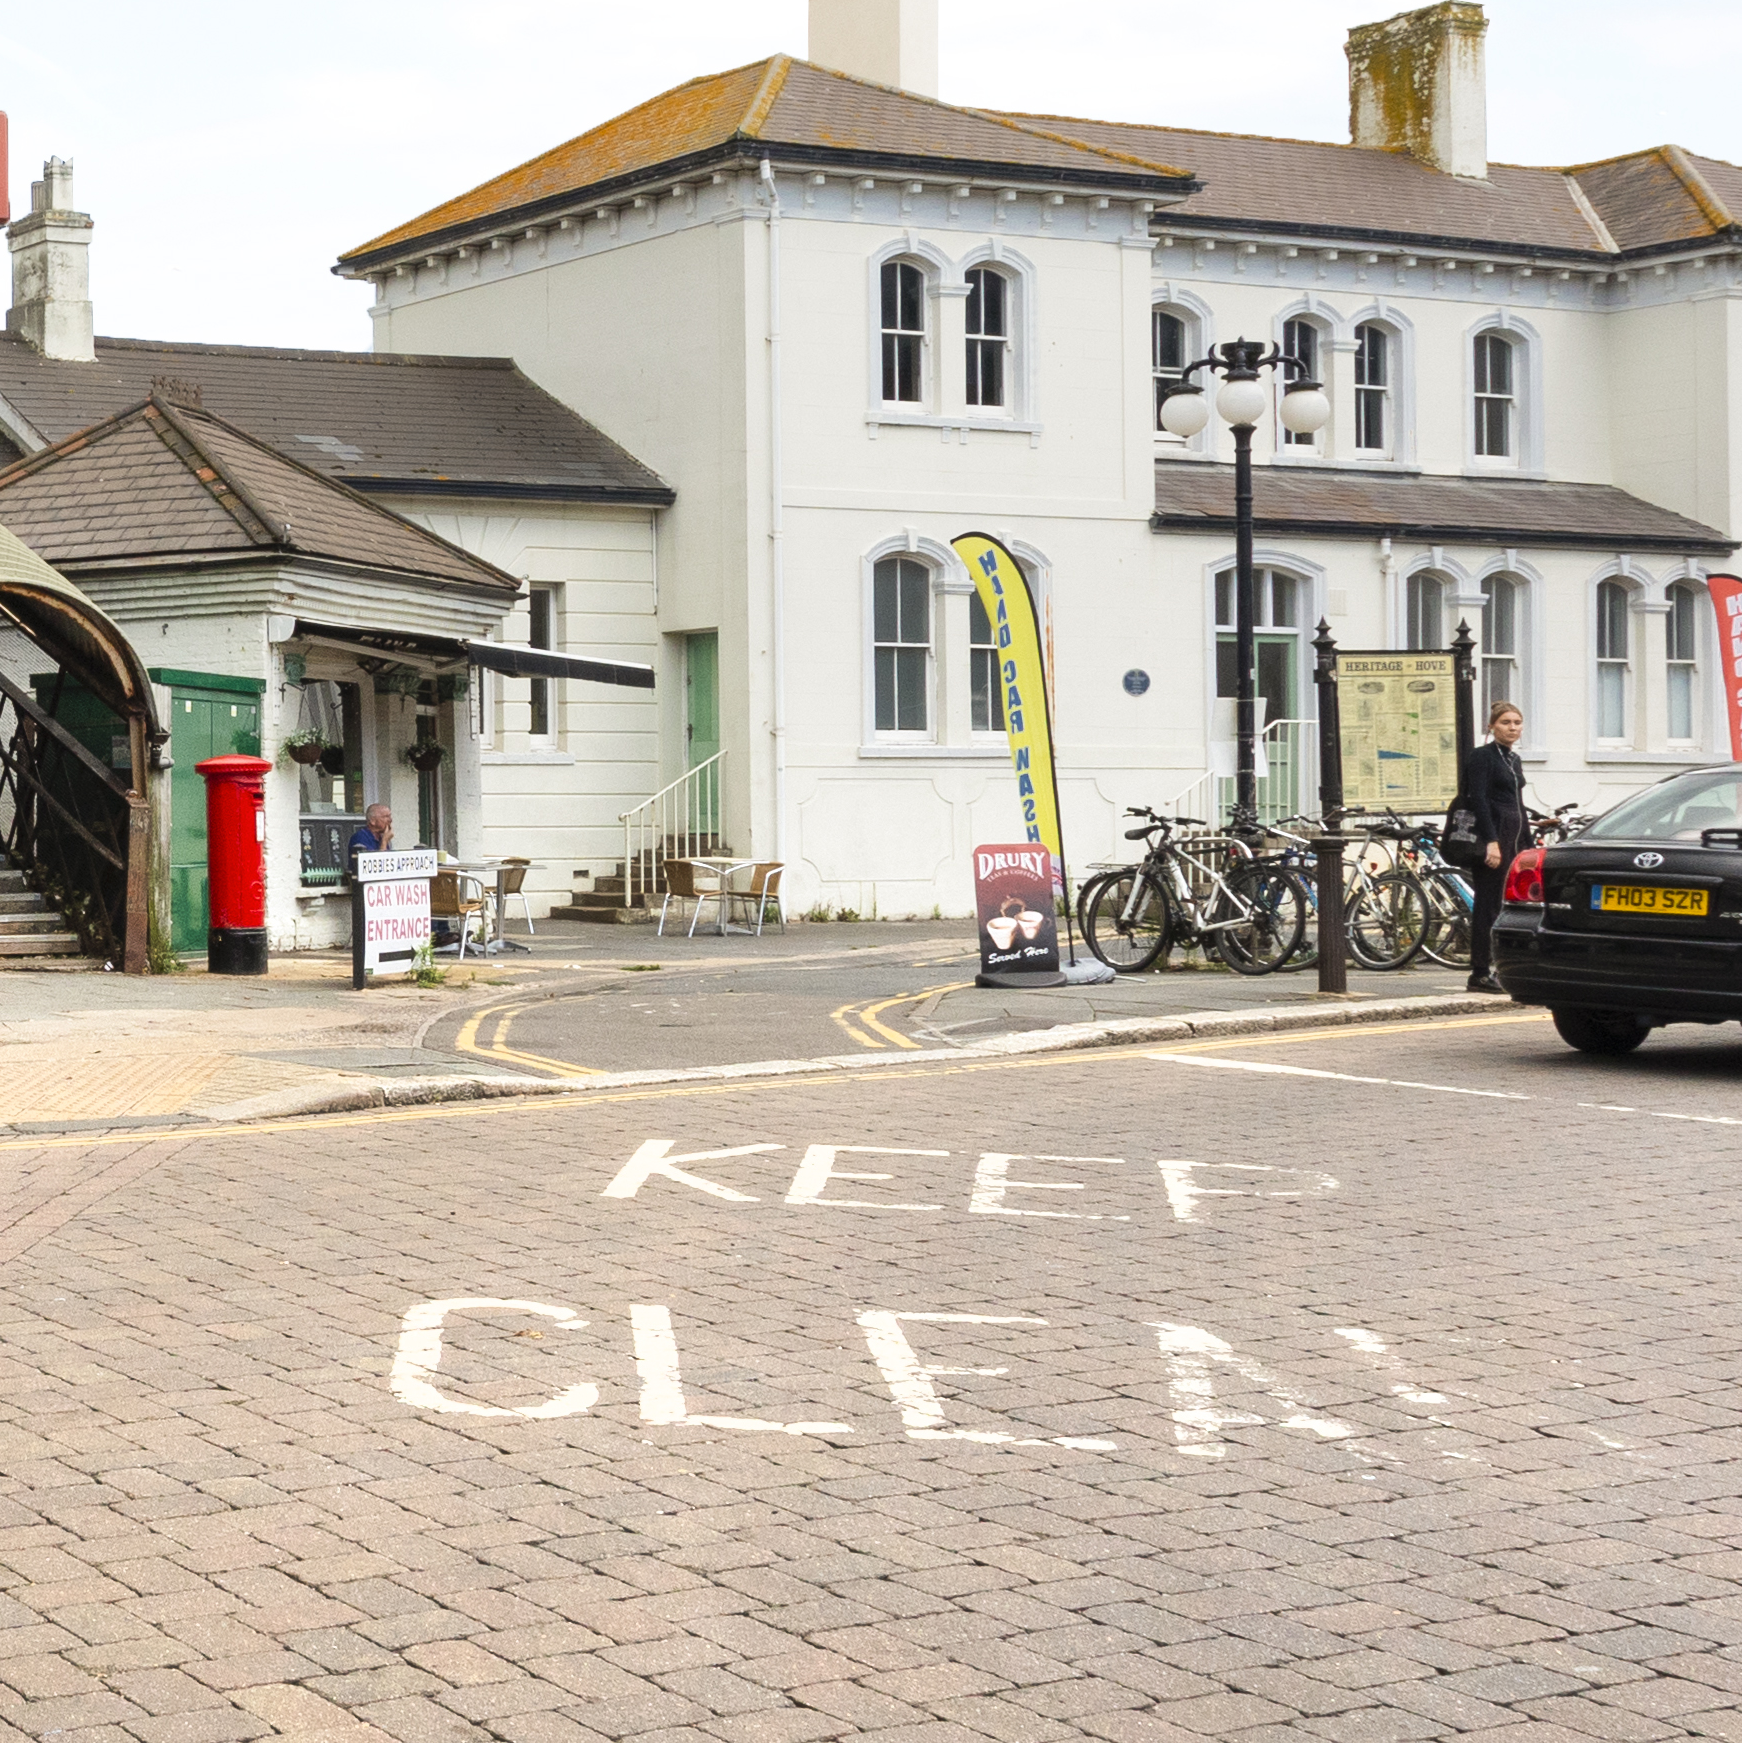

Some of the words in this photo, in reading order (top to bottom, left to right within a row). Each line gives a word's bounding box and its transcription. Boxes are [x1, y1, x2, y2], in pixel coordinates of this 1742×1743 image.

[1345, 660, 1403, 672] HERITAGE
[1415, 660, 1446, 671] HOVE
[362, 858, 395, 875] ROBBIES
[396, 856, 434, 872] APPROACH
[977, 851, 1046, 881] DRURY
[367, 885, 392, 907] CAR
[395, 884, 428, 906] WASH
[1604, 887, 1656, 908] FH03
[1662, 890, 1703, 910] SZR
[367, 916, 430, 942] ENTRANCE
[988, 949, 1022, 964] Served
[1023, 946, 1049, 957] Here
[599, 1138, 1341, 1224] KEEP
